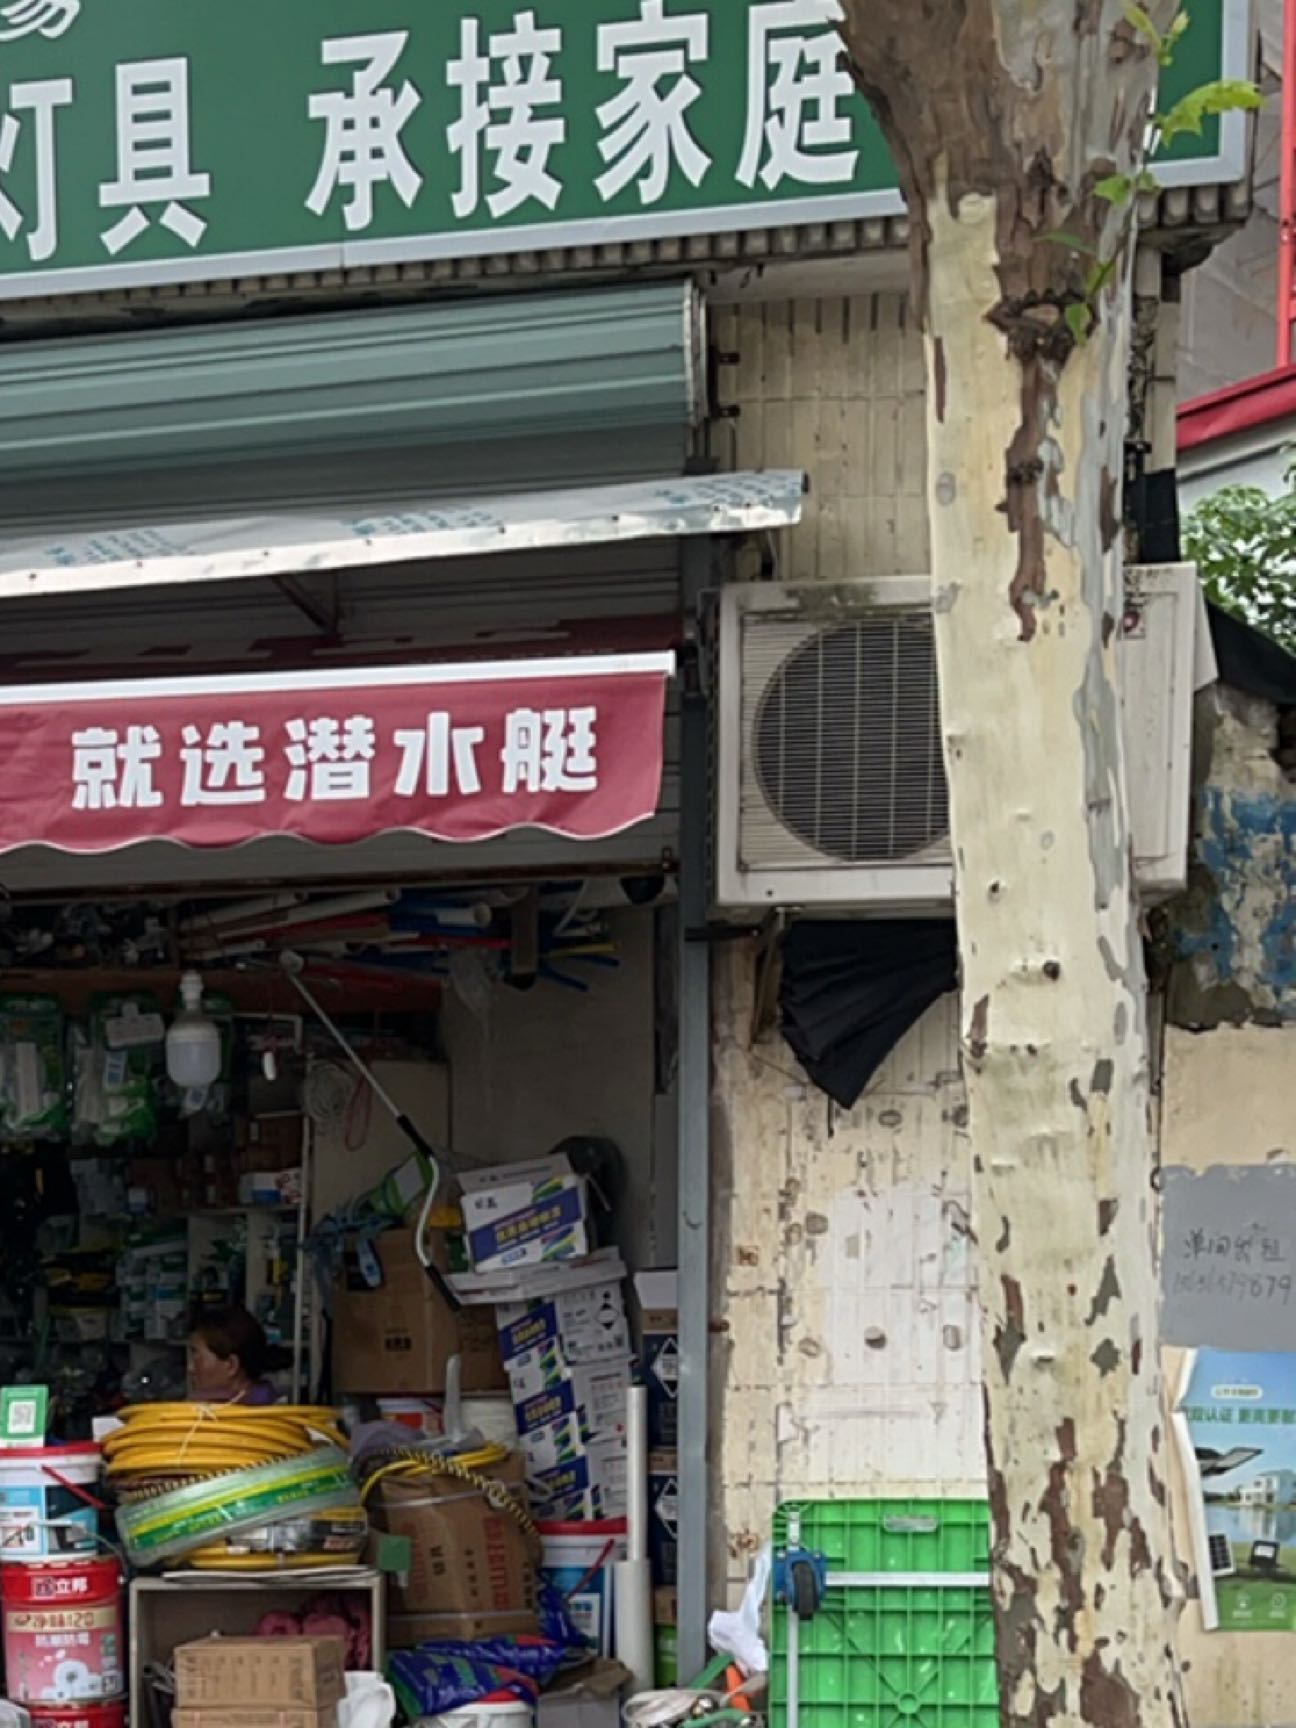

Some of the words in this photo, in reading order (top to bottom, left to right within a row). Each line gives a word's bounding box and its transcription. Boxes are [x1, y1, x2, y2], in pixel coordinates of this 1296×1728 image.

[307, 0, 861, 231] 承接家庭
[70, 705, 598, 810] 就选潜水艇
